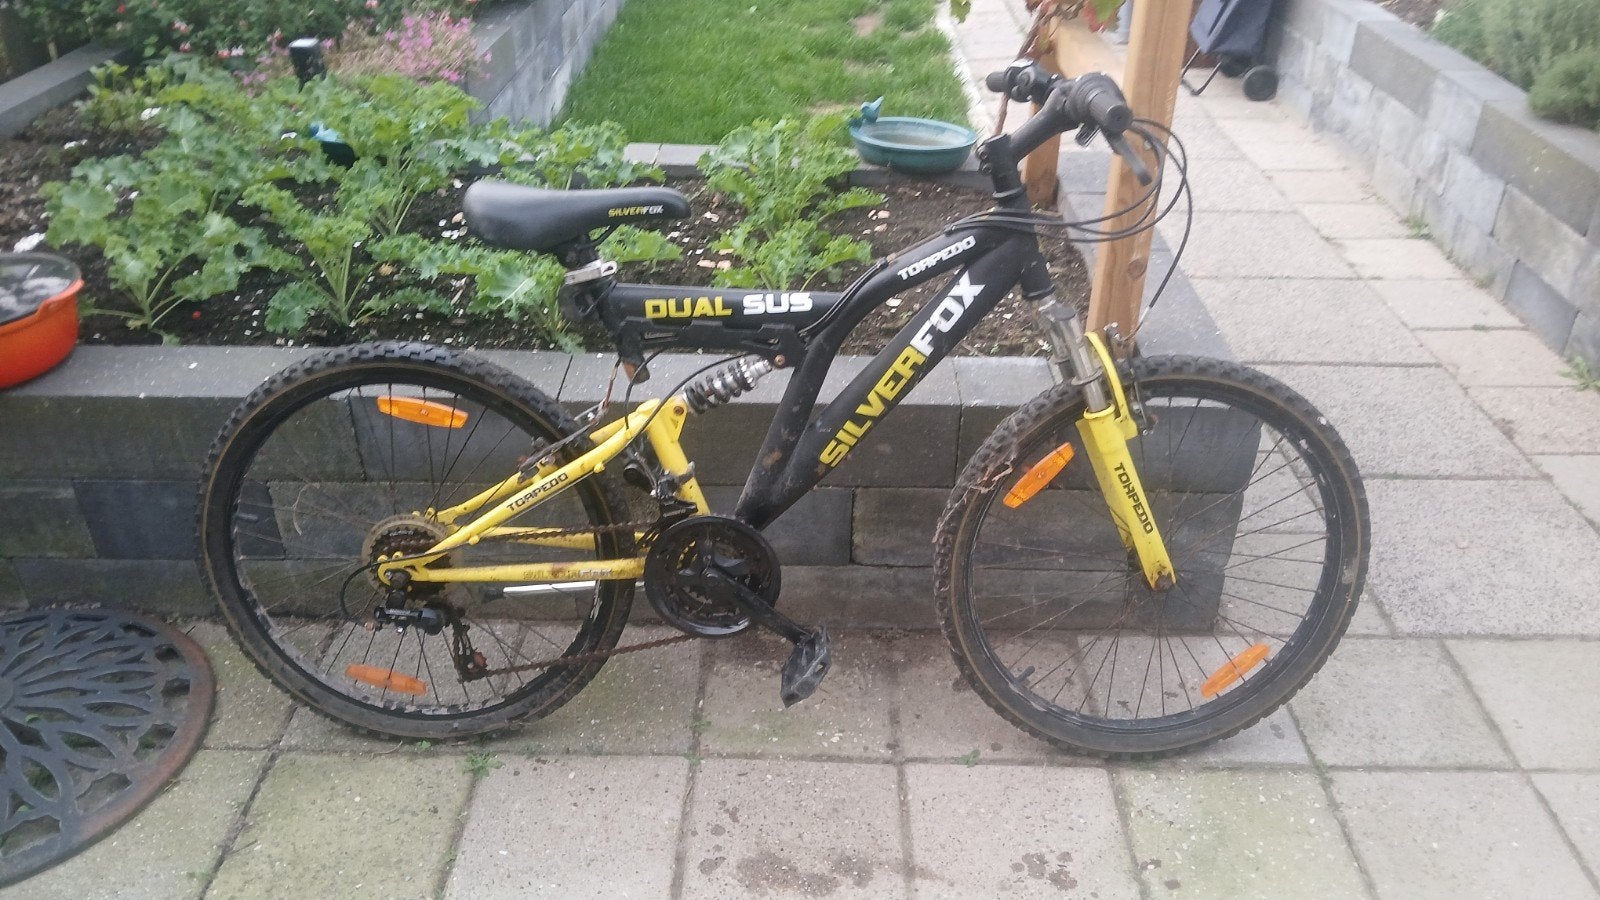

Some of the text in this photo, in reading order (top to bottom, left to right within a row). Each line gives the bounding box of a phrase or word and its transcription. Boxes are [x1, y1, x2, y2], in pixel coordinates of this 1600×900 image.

[608, 205, 664, 218] SILVERFOX
[897, 235, 976, 280] TORPEDO
[645, 292, 813, 319] DUAL SUS
[819, 270, 986, 468] SILVERFOX
[506, 472, 569, 512] TORPEDO
[1114, 462, 1154, 534] TORPEDO
